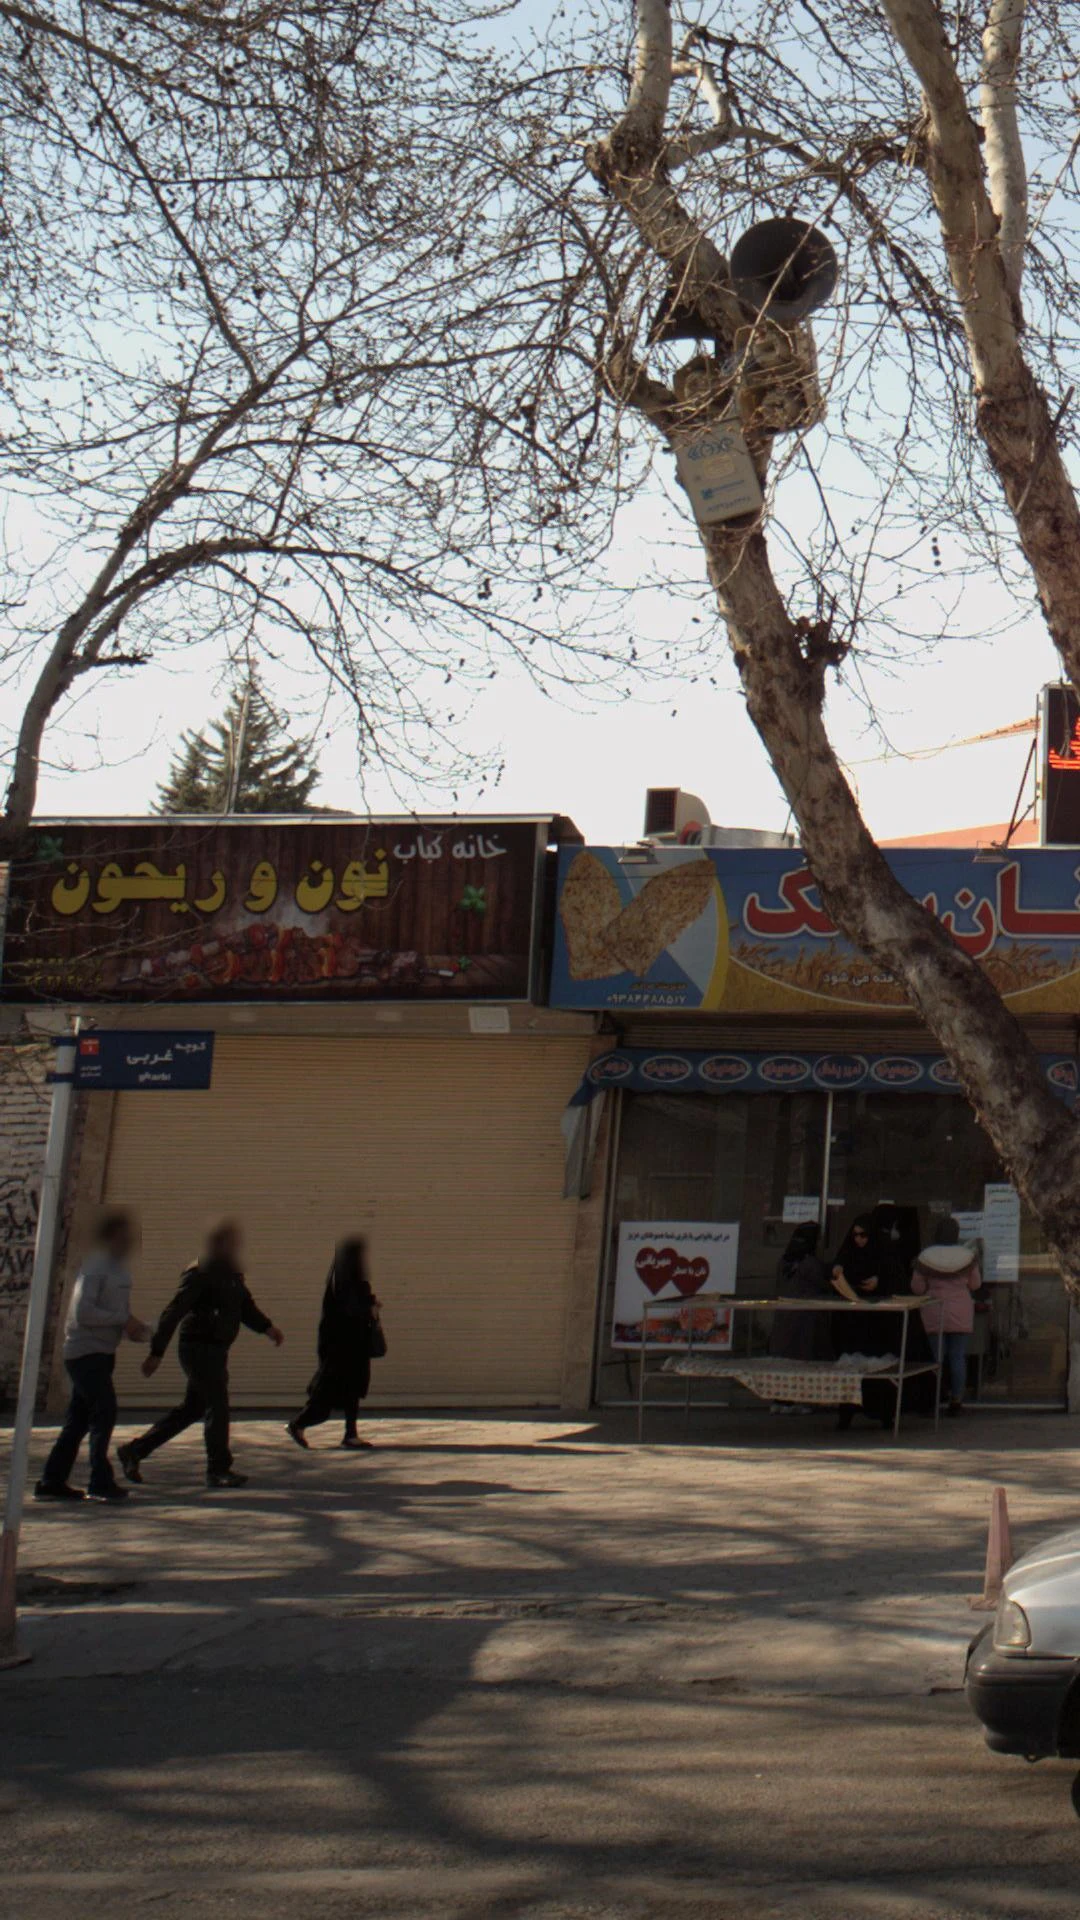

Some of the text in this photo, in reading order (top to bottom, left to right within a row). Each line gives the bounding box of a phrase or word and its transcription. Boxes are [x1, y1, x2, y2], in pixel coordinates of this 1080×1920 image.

[392, 833, 508, 865] خانه کباب
[52, 848, 389, 915] نون و ریحون
[126, 1049, 173, 1065] غربی
[174, 1041, 207, 1053] کوچه
